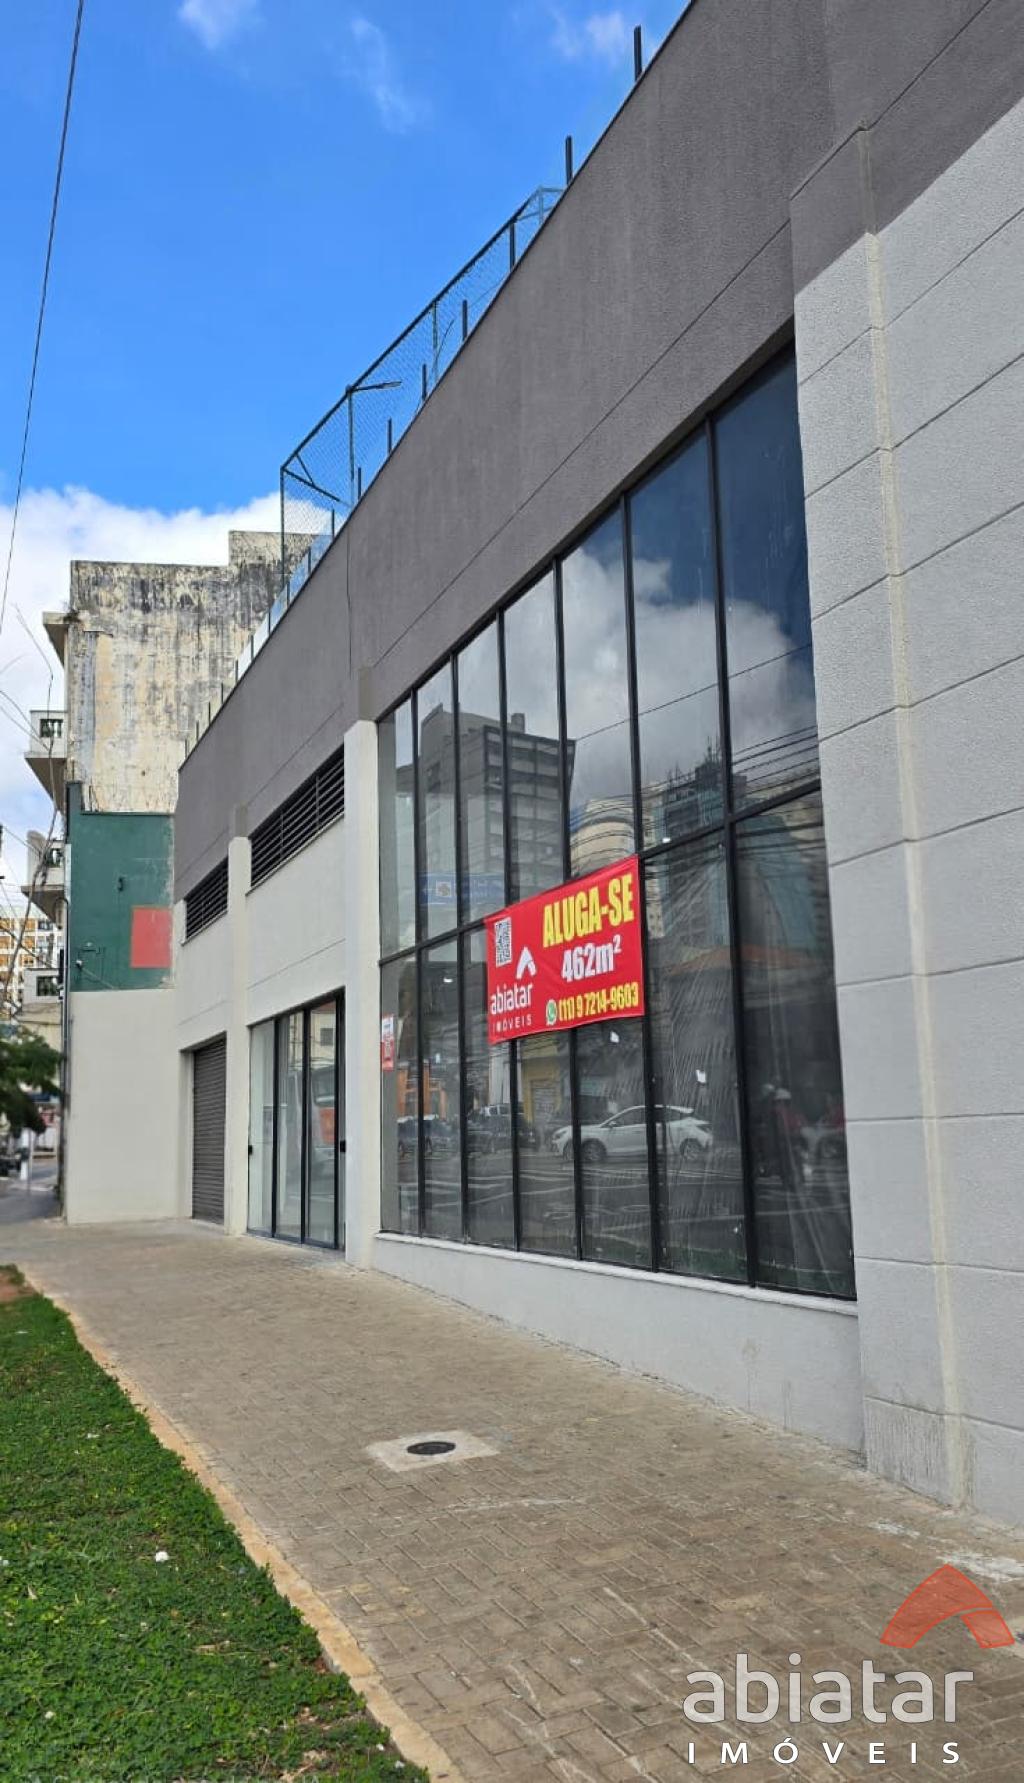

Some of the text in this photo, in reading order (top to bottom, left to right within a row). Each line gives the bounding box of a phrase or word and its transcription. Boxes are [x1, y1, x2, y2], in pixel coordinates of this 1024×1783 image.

[542, 872, 634, 948] ALUGA-SE
[560, 934, 622, 983] 462m²
[490, 982, 533, 1015] abiatar
